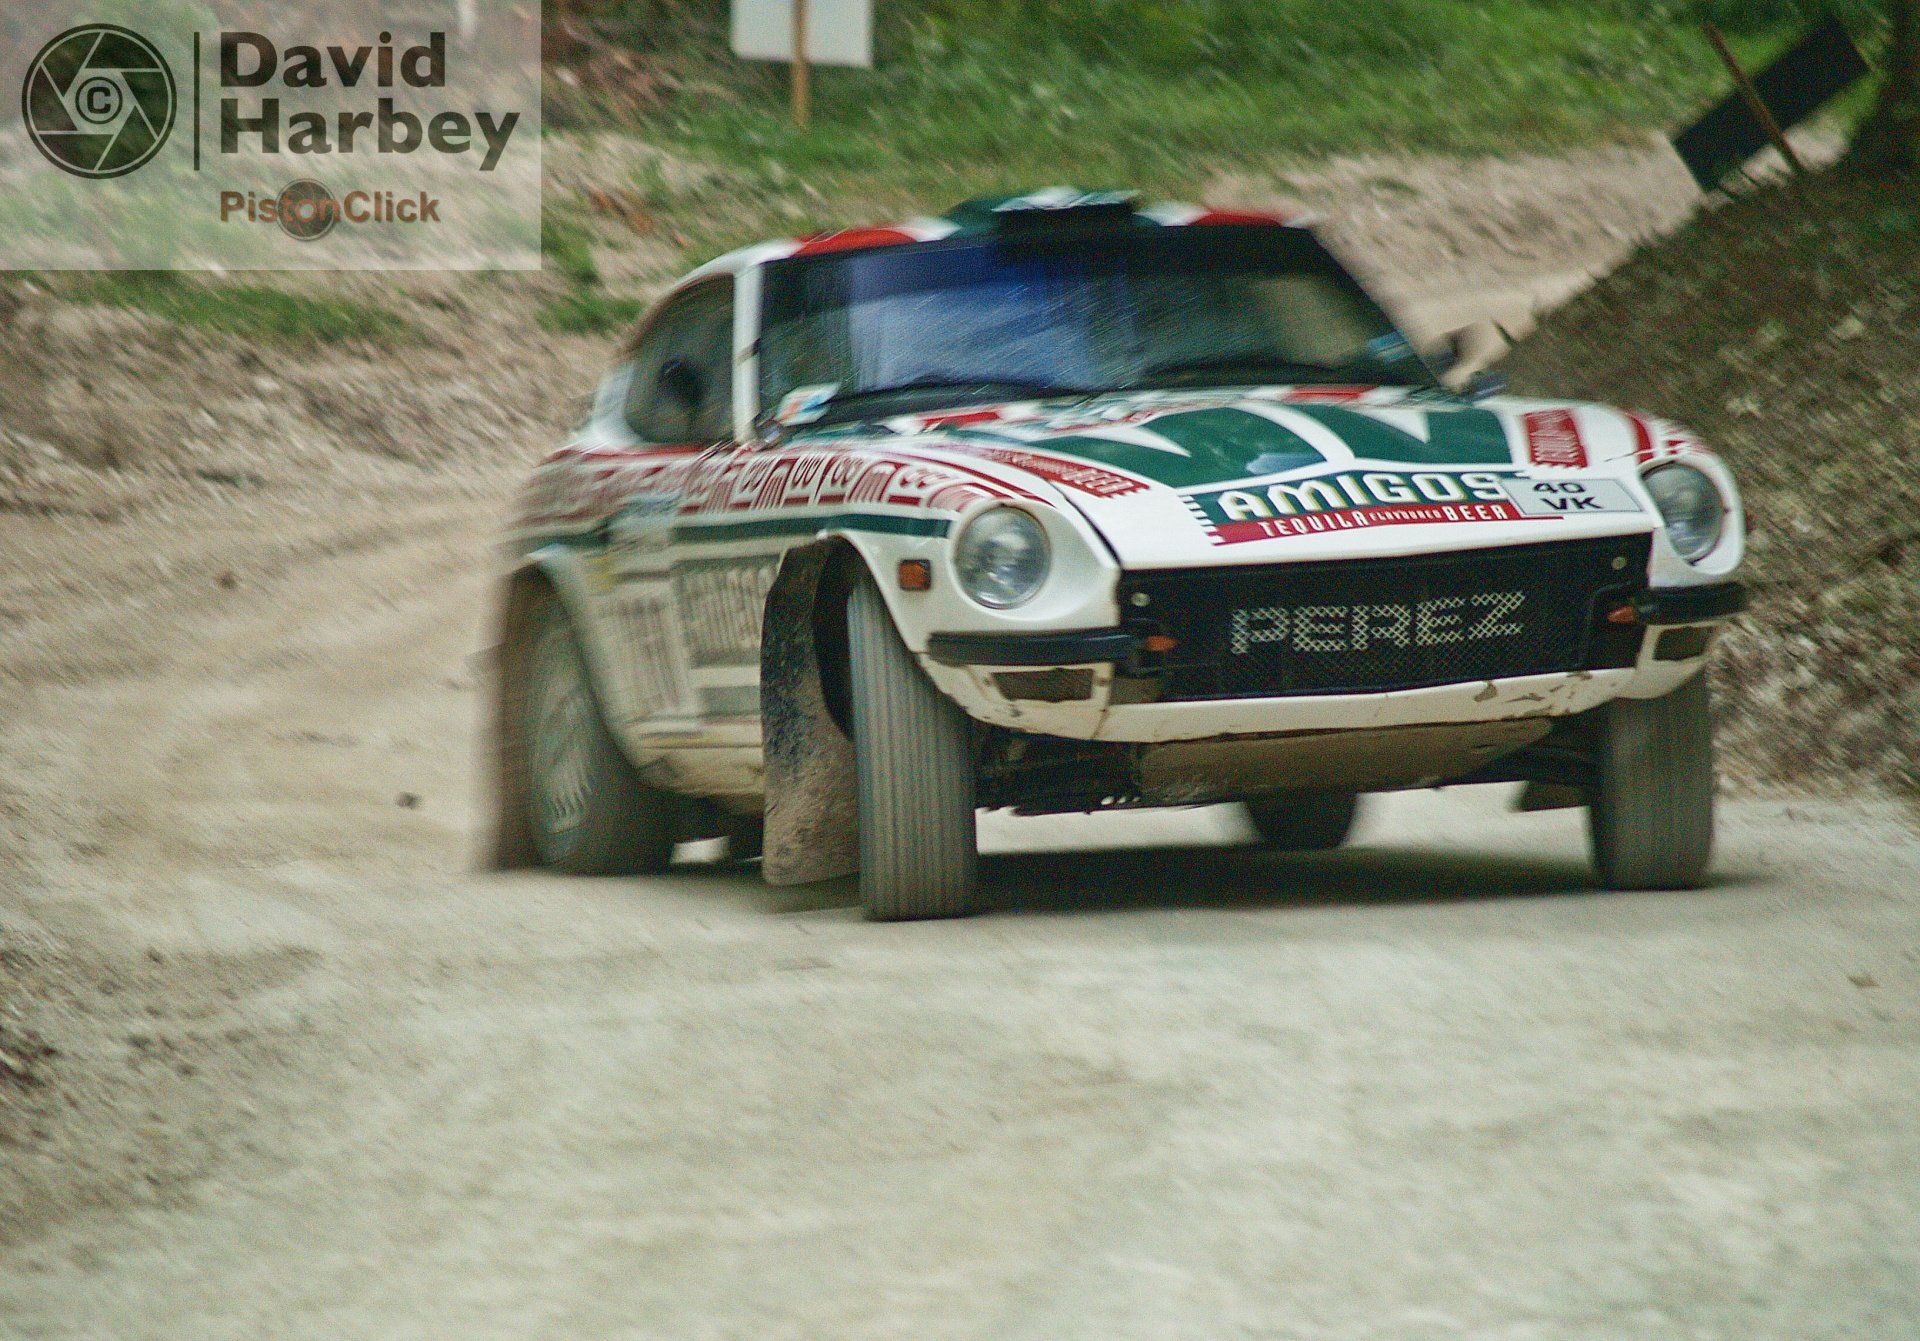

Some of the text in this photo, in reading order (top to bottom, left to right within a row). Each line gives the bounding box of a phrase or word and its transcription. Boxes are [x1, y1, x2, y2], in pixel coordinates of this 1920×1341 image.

[1218, 472, 1509, 521] AMIGOS
[1533, 482, 1586, 494] 40
[1541, 496, 1603, 511] VK
[1260, 504, 1508, 537] TEQUILA FLAVOURED BEER
[1231, 591, 1526, 655] PEREZ
